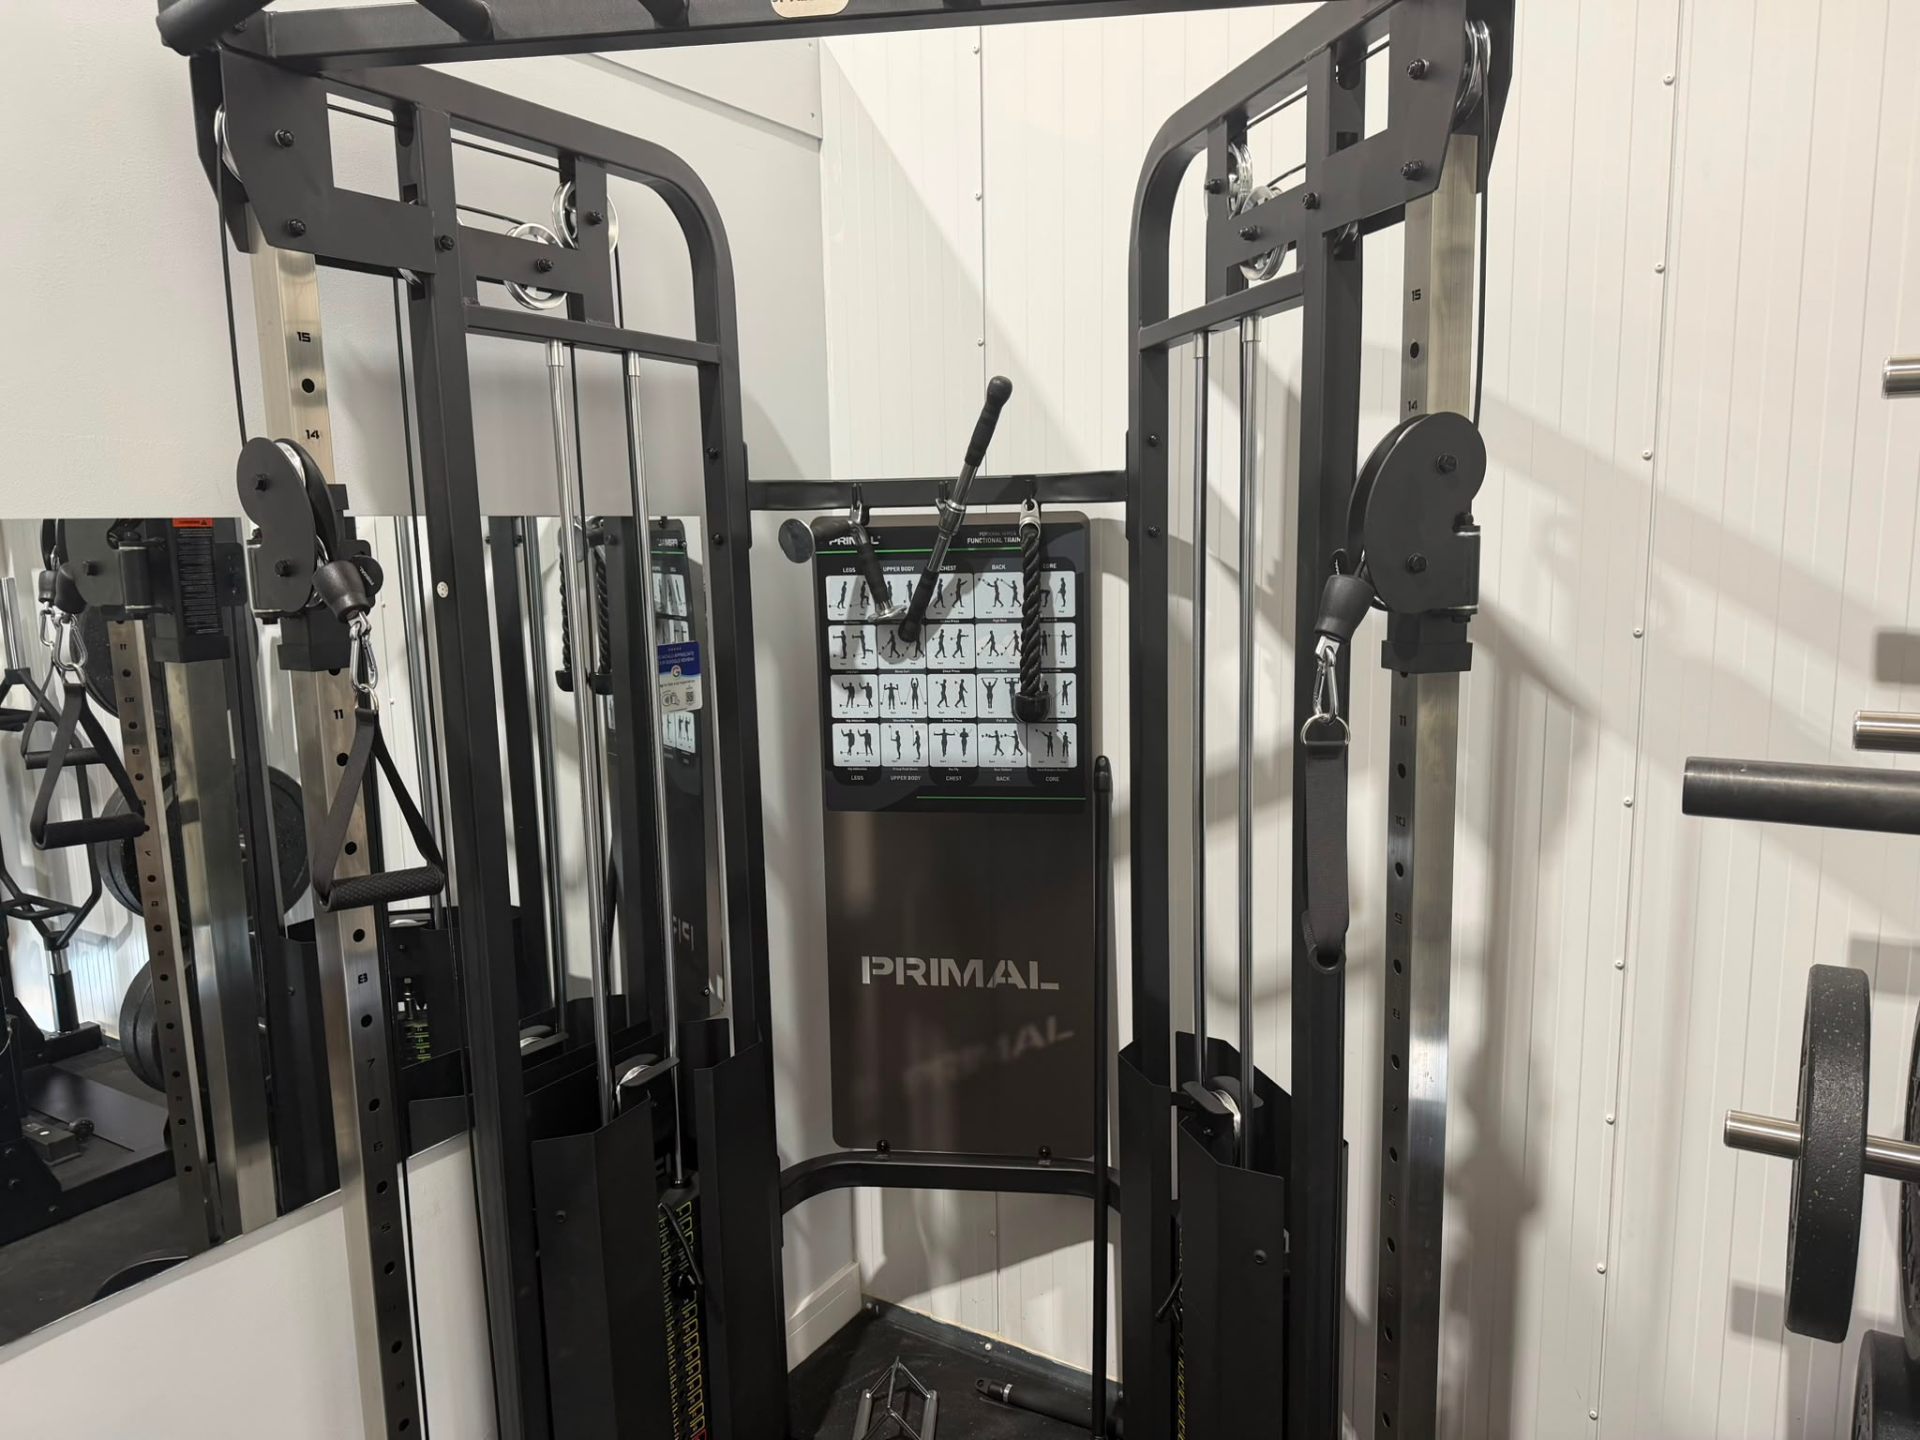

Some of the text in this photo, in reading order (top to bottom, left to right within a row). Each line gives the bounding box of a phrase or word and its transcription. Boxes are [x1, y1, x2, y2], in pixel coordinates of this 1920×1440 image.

[1411, 289, 1422, 302] 15
[297, 332, 311, 342] 15
[1408, 400, 1418, 412] 14
[306, 430, 320, 440] 14
[334, 709, 344, 720] 11
[1399, 714, 1407, 727] 11
[358, 973, 368, 984] 8
[862, 956, 1060, 990] PRIMAL
[367, 1058, 375, 1070] 7
[373, 1141, 383, 1152] 6
